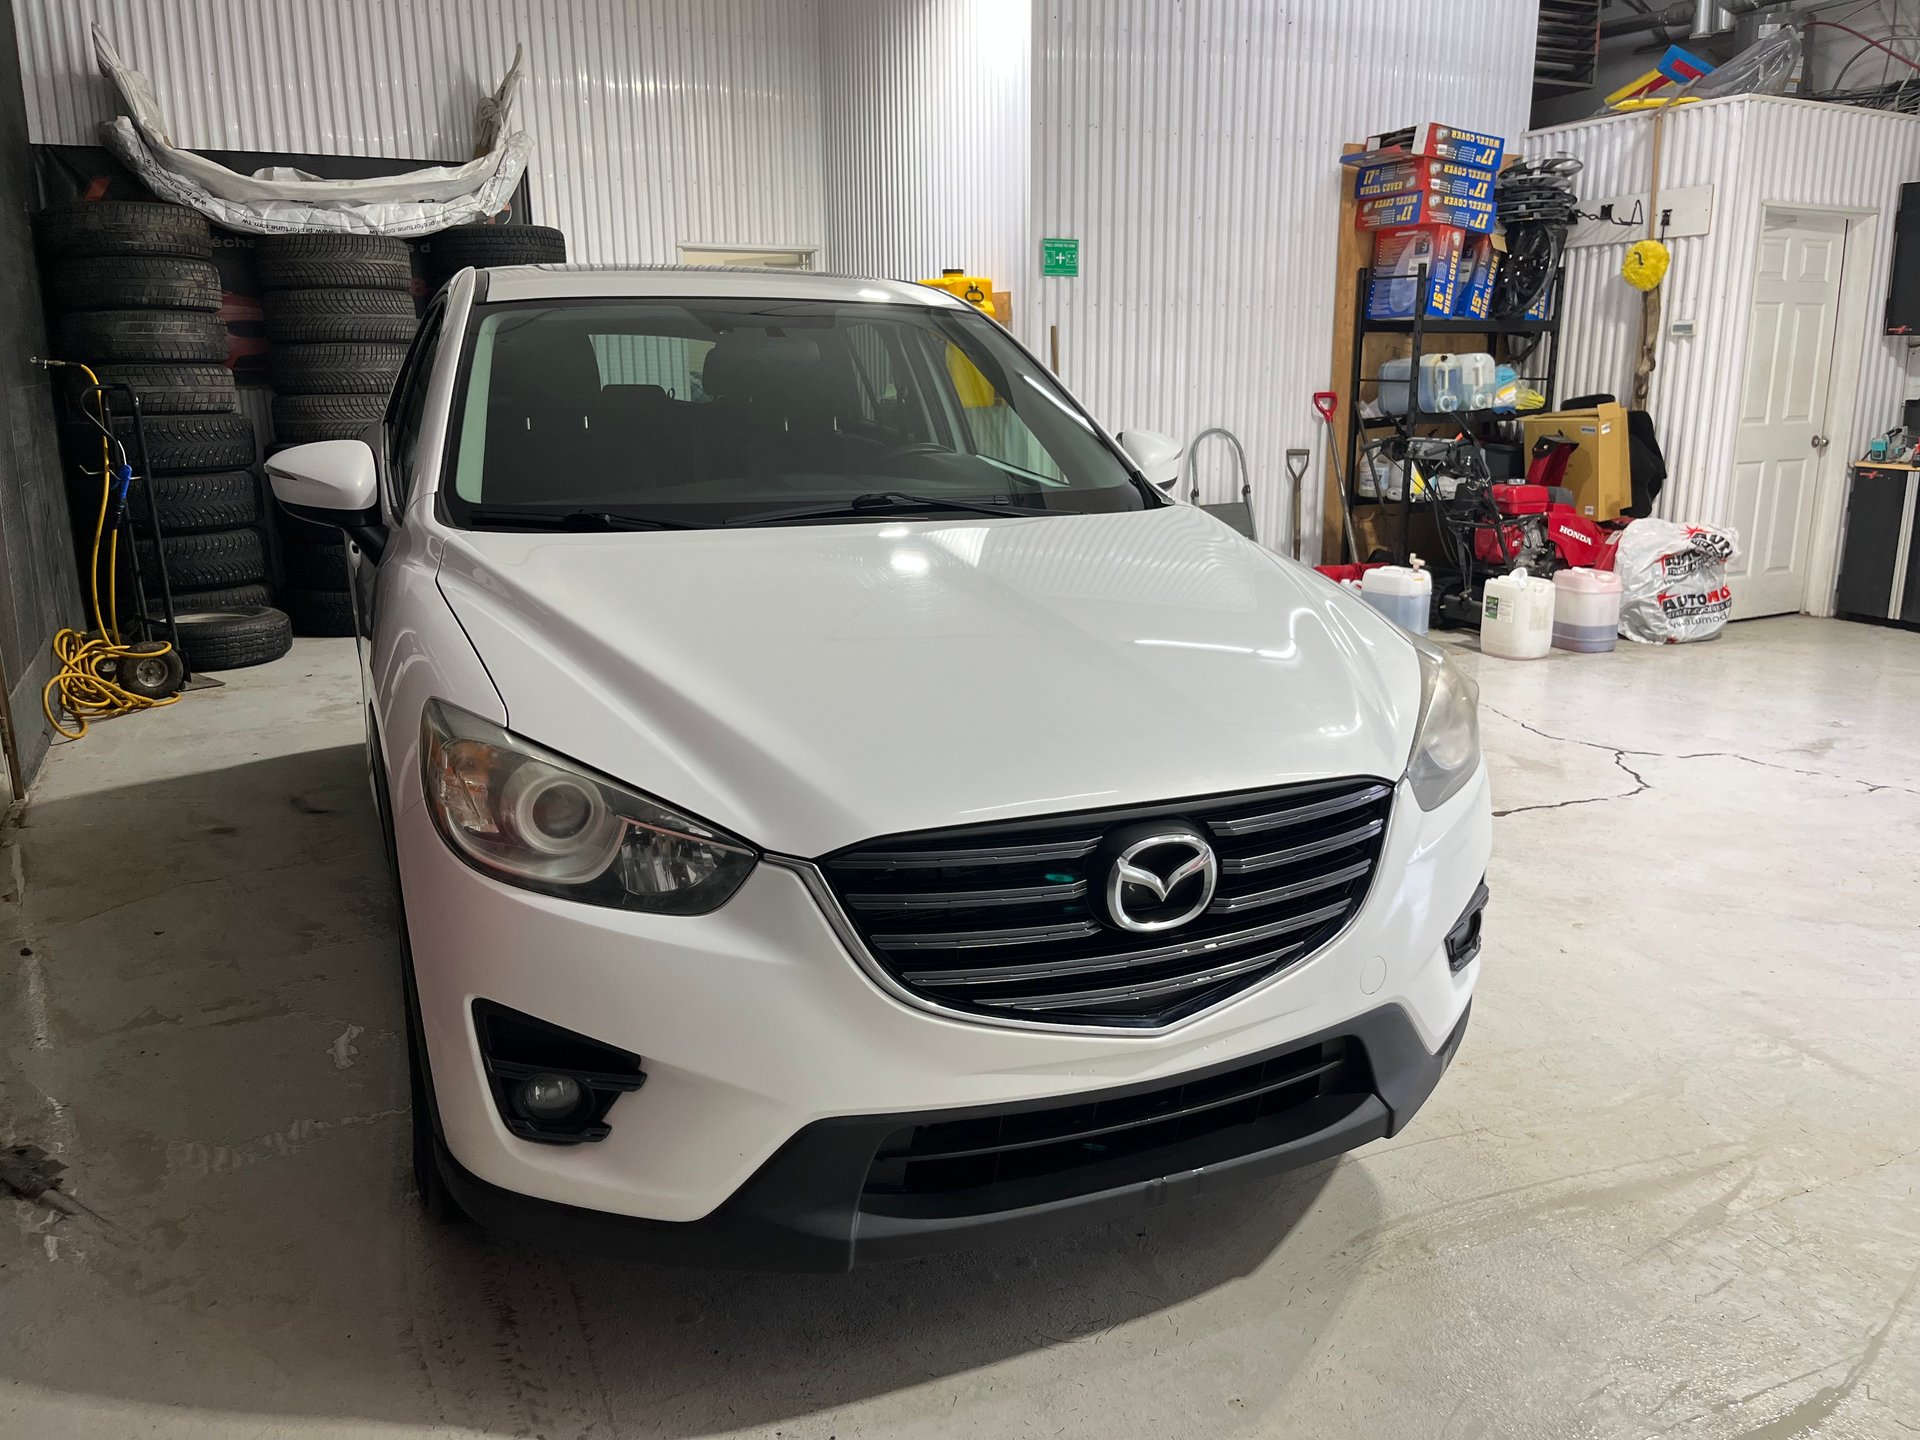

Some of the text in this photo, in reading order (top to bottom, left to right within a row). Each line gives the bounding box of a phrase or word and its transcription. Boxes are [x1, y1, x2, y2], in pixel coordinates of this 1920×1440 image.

[1451, 130, 1500, 148] WHEEL COVER
[1443, 164, 1492, 182] WHEEL COVER
[1443, 196, 1492, 212] WHEEL COVER
[1443, 250, 1459, 314] WHEEL COVER
[1480, 255, 1499, 318] WHEEL COVER
[1559, 524, 1592, 546] HONDA
